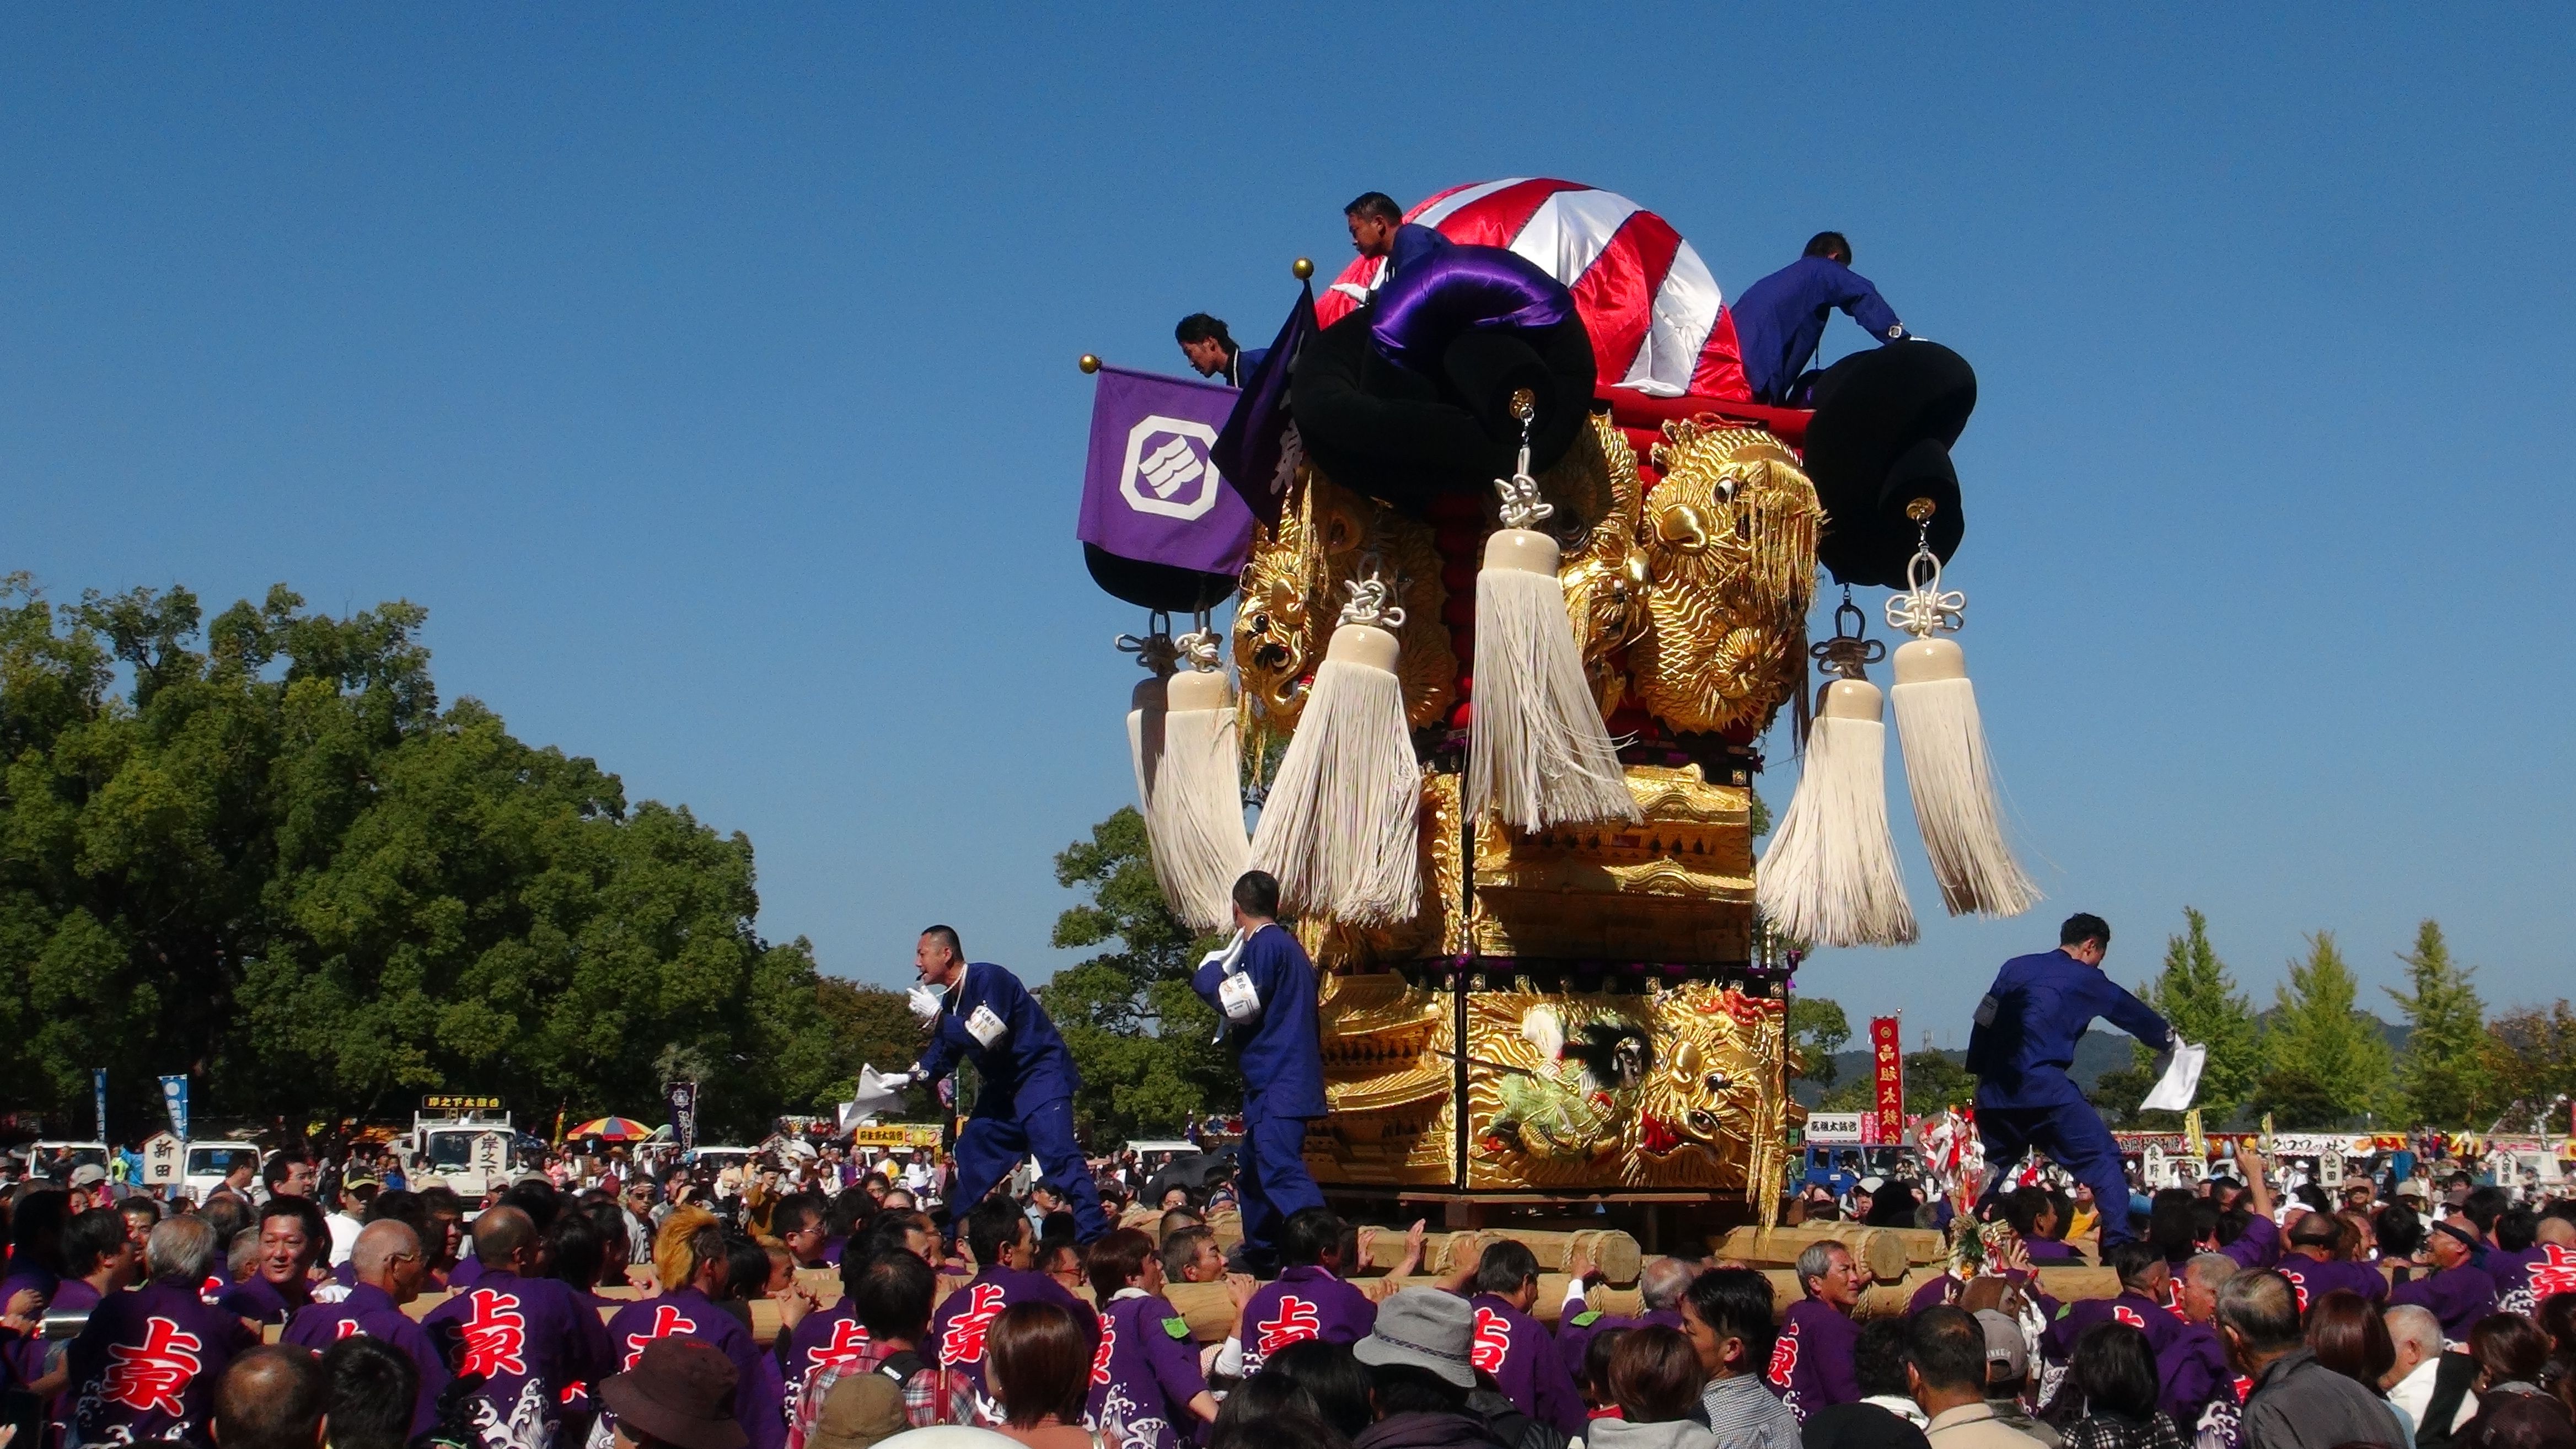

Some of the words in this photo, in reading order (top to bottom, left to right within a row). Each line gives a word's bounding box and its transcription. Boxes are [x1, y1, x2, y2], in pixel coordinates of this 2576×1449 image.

[153, 1139, 175, 1177] 新田
[479, 1135, 498, 1178] 岸之下
[2148, 1146, 2160, 1178] 長野
[2324, 1155, 2337, 1181] 池田
